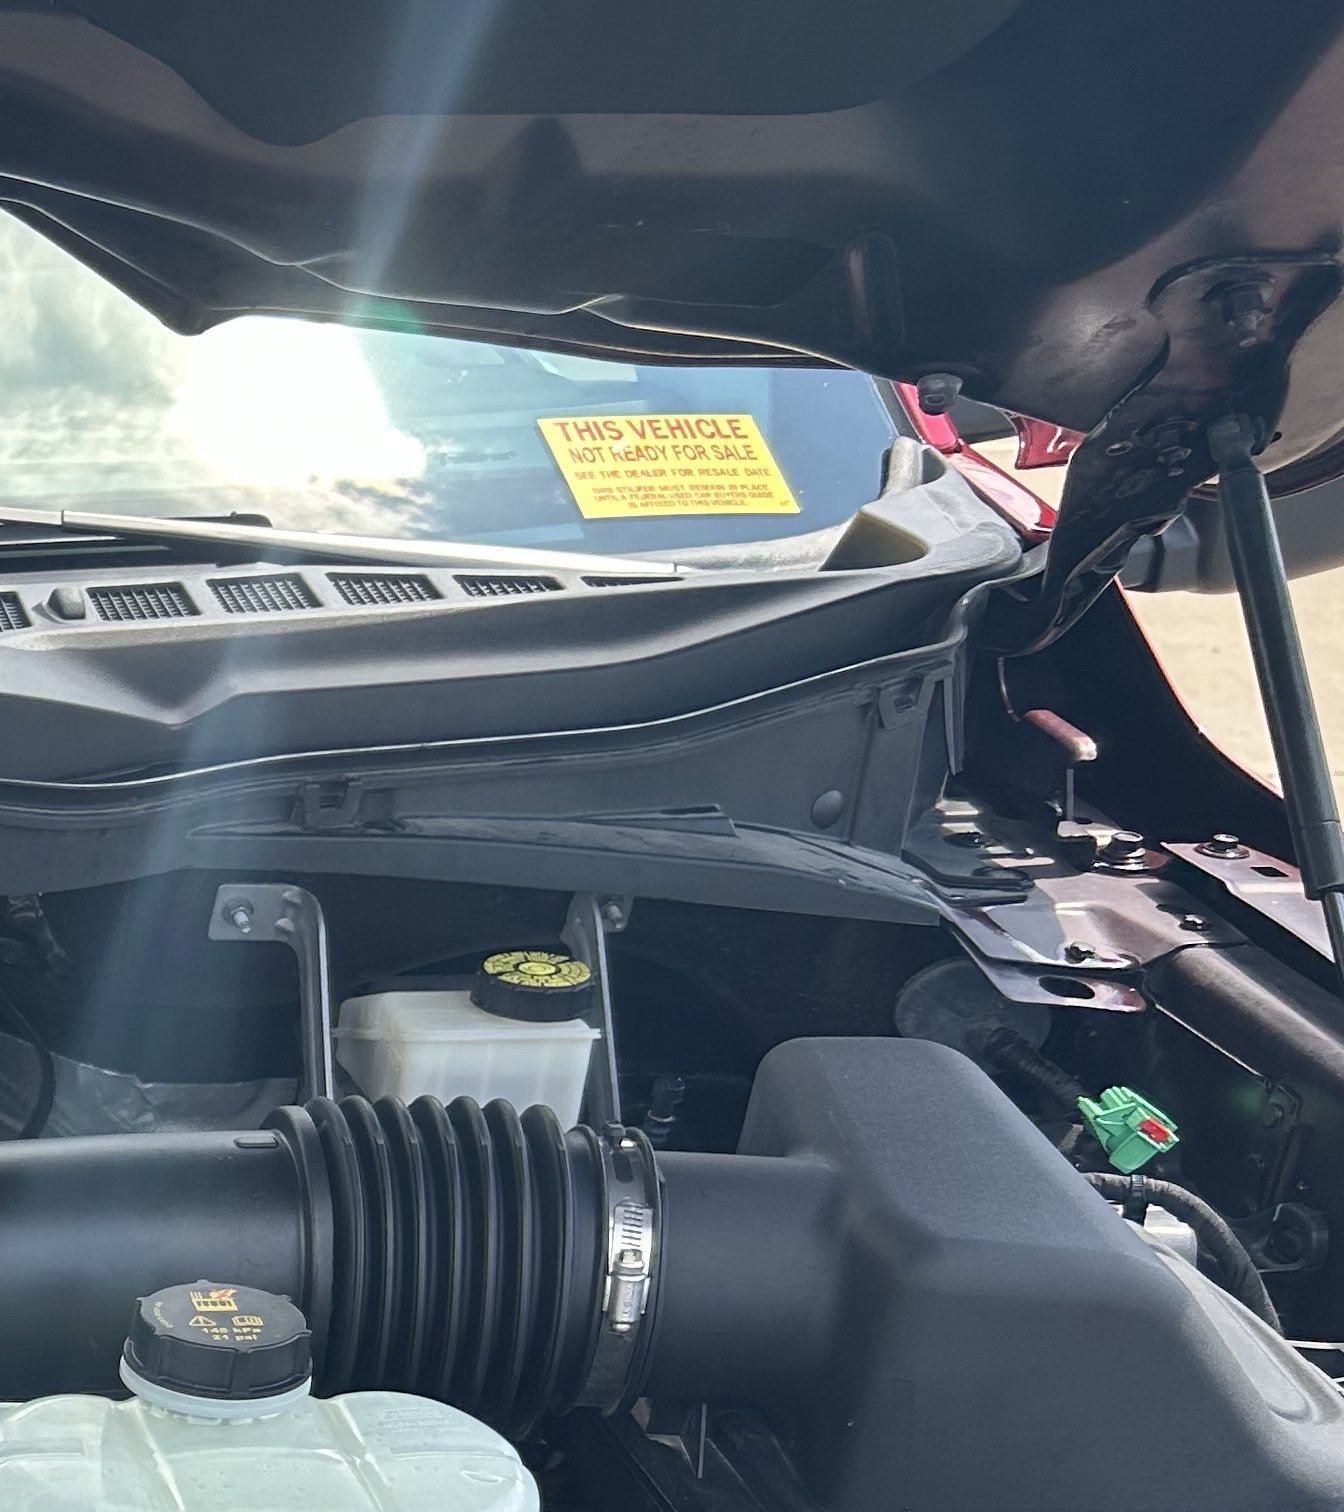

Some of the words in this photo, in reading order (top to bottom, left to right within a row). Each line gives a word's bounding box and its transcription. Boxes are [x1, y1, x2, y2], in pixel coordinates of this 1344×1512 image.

[553, 420, 625, 442] THIS
[626, 418, 749, 440] VEHICLE
[568, 447, 606, 464] NOT
[609, 444, 669, 463] READY
[671, 444, 711, 462] FOR
[712, 444, 758, 461] SALE
[600, 470, 621, 479] THE
[624, 469, 666, 479] DEALER
[670, 468, 694, 477] FOR
[698, 468, 741, 477] RESALE
[744, 467, 772, 477] DATE
